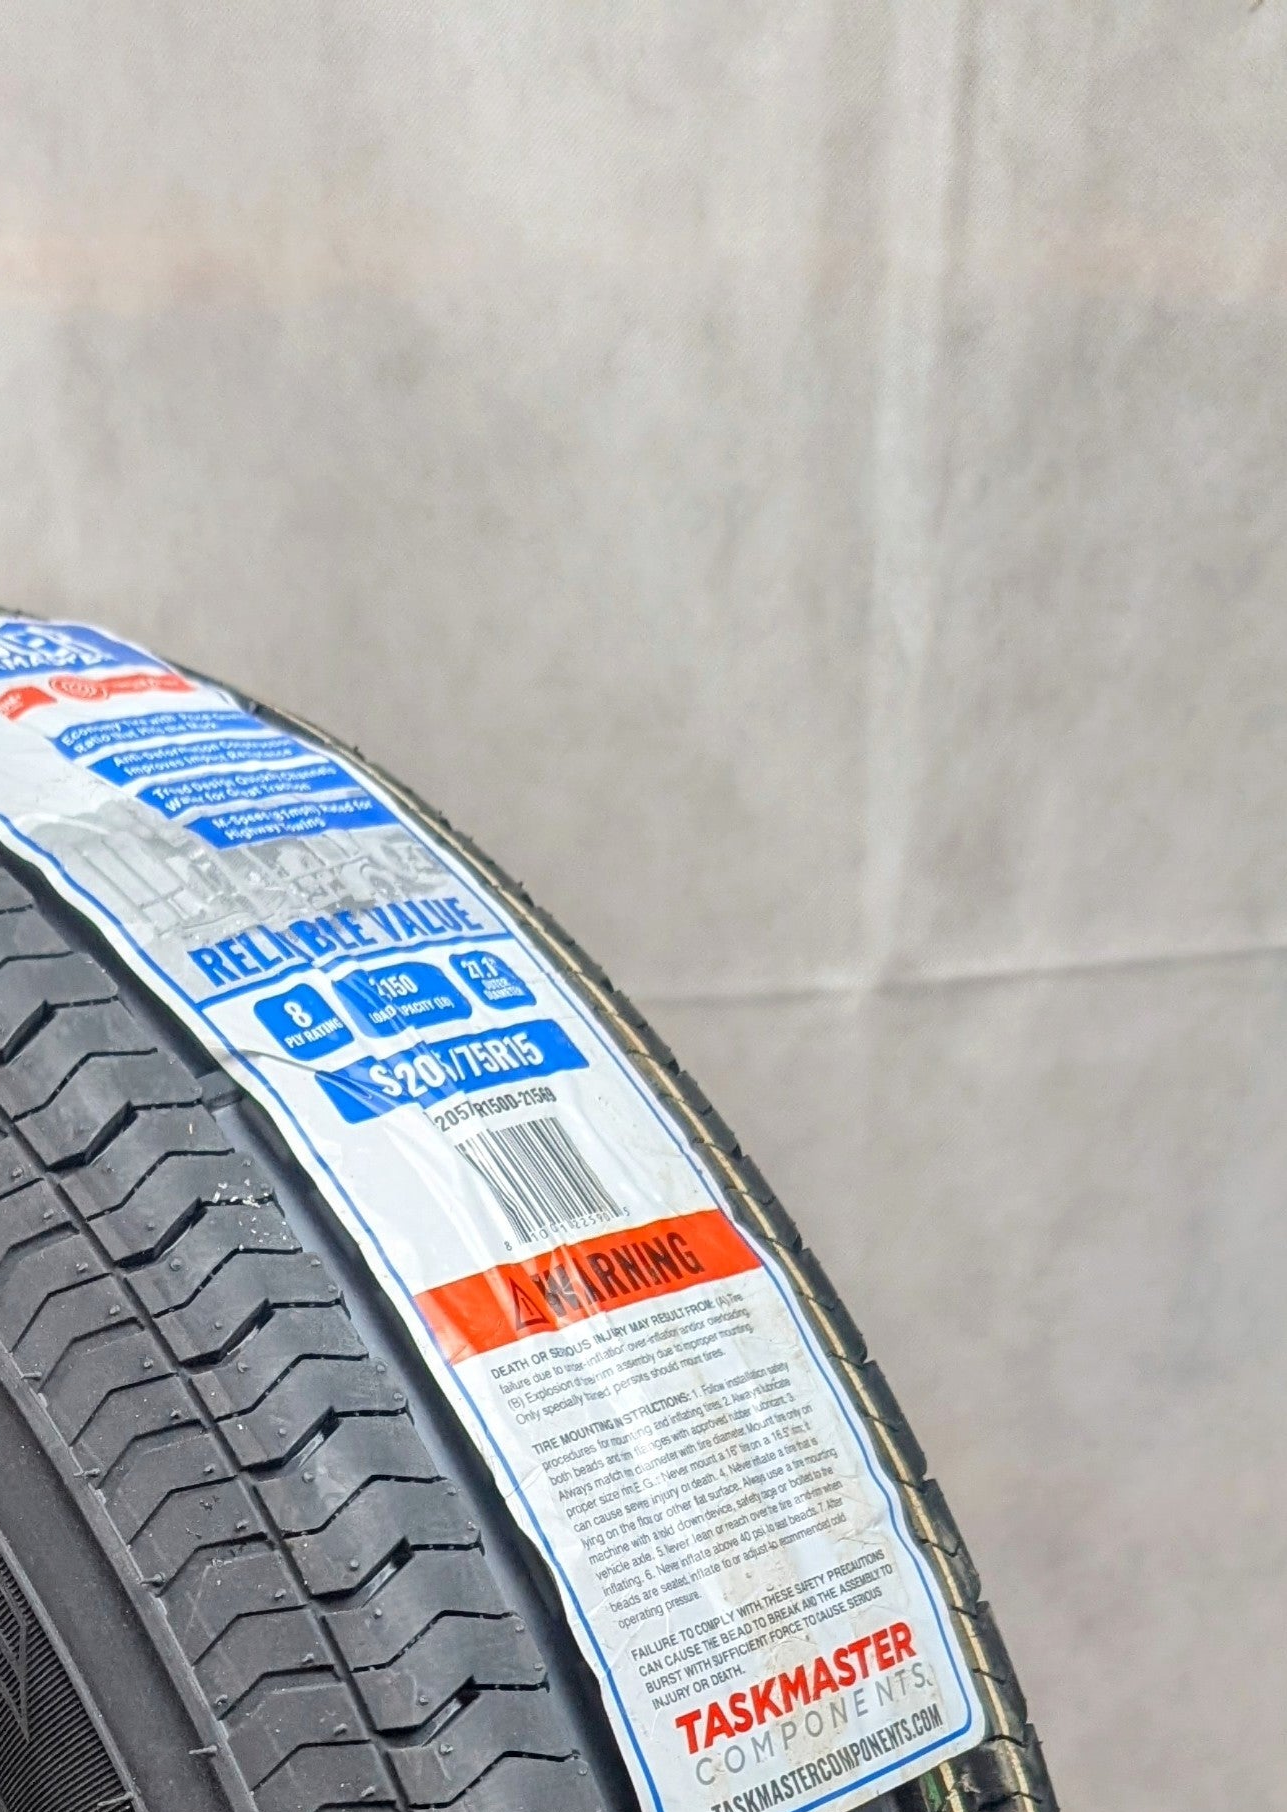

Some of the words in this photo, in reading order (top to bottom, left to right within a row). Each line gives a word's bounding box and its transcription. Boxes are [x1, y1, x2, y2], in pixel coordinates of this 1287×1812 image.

[364, 897, 484, 941] VALUE
[283, 1000, 312, 1028] 8
[285, 1030, 311, 1049] PLY
[307, 1016, 345, 1042] RATING
[368, 1004, 398, 1024] LOAD
[529, 1231, 706, 1319] WARNING
[491, 1359, 529, 1379] DEATH
[531, 1351, 548, 1364] OR
[628, 1318, 649, 1332] MAY
[650, 1307, 684, 1325] RESULT
[499, 1378, 531, 1394] failure
[533, 1370, 552, 1383] due
[552, 1366, 563, 1375] to
[507, 1396, 525, 1409] (B)
[524, 1380, 574, 1403] Explosion
[656, 1347, 673, 1358] due
[516, 1410, 540, 1424] Only
[542, 1394, 583, 1416] specially
[650, 1361, 679, 1378] should
[702, 1348, 725, 1361] tires.
[532, 1437, 559, 1454] TIRE
[559, 1419, 614, 1445] MOUNTING
[613, 1392, 691, 1428] INSTRUCTIONS:
[542, 1444, 597, 1473] procedures
[597, 1439, 609, 1448] for
[653, 1416, 669, 1430] and
[670, 1407, 704, 1424] inflating
[548, 1471, 572, 1486] both
[572, 1459, 604, 1477] beads
[671, 1428, 689, 1441] with
[691, 1414, 728, 1435] approved
[786, 1392, 795, 1402] 3.
[558, 1482, 593, 1501] Always
[594, 1470, 624, 1487] match
[634, 1451, 678, 1474] diameter
[679, 1444, 697, 1457] with
[696, 1439, 712, 1450] tire
[802, 1405, 812, 1414] on
[566, 1499, 597, 1519] proper
[599, 1491, 620, 1504] size
[661, 1465, 688, 1479] Never
[689, 1454, 717, 1471] mount
[718, 1452, 725, 1460] a
[763, 1437, 771, 1445] a
[573, 1520, 592, 1532] can
[593, 1508, 623, 1525] cause
[651, 1487, 679, 1504] injury
[691, 1473, 717, 1488] death.
[777, 1449, 784, 1457] a
[580, 1534, 605, 1550] lying
[605, 1528, 619, 1539] on
[619, 1521, 636, 1533] the
[653, 1512, 662, 1522] or
[666, 1500, 691, 1517] other
[707, 1483, 741, 1501] surface.
[766, 1467, 783, 1479] use
[785, 1463, 792, 1471] a
[588, 1543, 630, 1564] machine
[631, 1533, 651, 1547] with
[677, 1515, 704, 1531] down
[704, 1503, 736, 1520] device,
[736, 1492, 762, 1508] safety
[777, 1483, 787, 1493] or
[595, 1561, 630, 1580] vehicle
[632, 1553, 652, 1566] axle.
[692, 1529, 714, 1542] lean
[715, 1524, 723, 1534] or
[724, 1515, 749, 1530] reach
[749, 1508, 768, 1521] over
[778, 1499, 792, 1510] tire
[603, 1576, 644, 1596] inflating.
[644, 1569, 653, 1580] 6.
[656, 1561, 680, 1575] Never
[680, 1548, 711, 1567] inflate
[712, 1538, 739, 1554] above
[740, 1531, 751, 1541] 40
[752, 1528, 766, 1541] psi
[609, 1594, 641, 1612] beads
[642, 1588, 658, 1600] are
[690, 1563, 721, 1582] inflate
[721, 1559, 732, 1568] to
[732, 1555, 740, 1564] or
[743, 1543, 768, 1560] adjust
[618, 1604, 664, 1629] operating
[631, 1634, 678, 1661] FAILURE
[678, 1627, 694, 1641] TO
[694, 1611, 734, 1635] COMPLY
[736, 1600, 763, 1617] WITH
[761, 1587, 794, 1607] THESE
[794, 1574, 824, 1594] SAFETY
[826, 1549, 884, 1581] PRECAUTIONS
[639, 1659, 663, 1676] CAN
[664, 1643, 702, 1666] CAUSE
[701, 1636, 719, 1650] THE
[719, 1623, 752, 1644] BEAD
[752, 1617, 766, 1630] TO
[767, 1602, 801, 1624] BREAK
[802, 1596, 817, 1610] AND
[816, 1587, 838, 1602] THE
[839, 1568, 880, 1594] ASSEMBLY
[879, 1564, 892, 1575] TO
[645, 1669, 681, 1693] BURST
[683, 1658, 712, 1677] WITH
[711, 1634, 768, 1666] SUFFICIENT
[769, 1620, 803, 1642] FORCE
[802, 1614, 816, 1627] TO
[816, 1602, 847, 1622] CAUSE
[846, 1586, 882, 1609] SERIOUS
[652, 1685, 690, 1709] INJURY
[693, 1678, 709, 1692] OR
[710, 1664, 745, 1685] DEATH.
[675, 1621, 917, 1755] TASKMASTER
